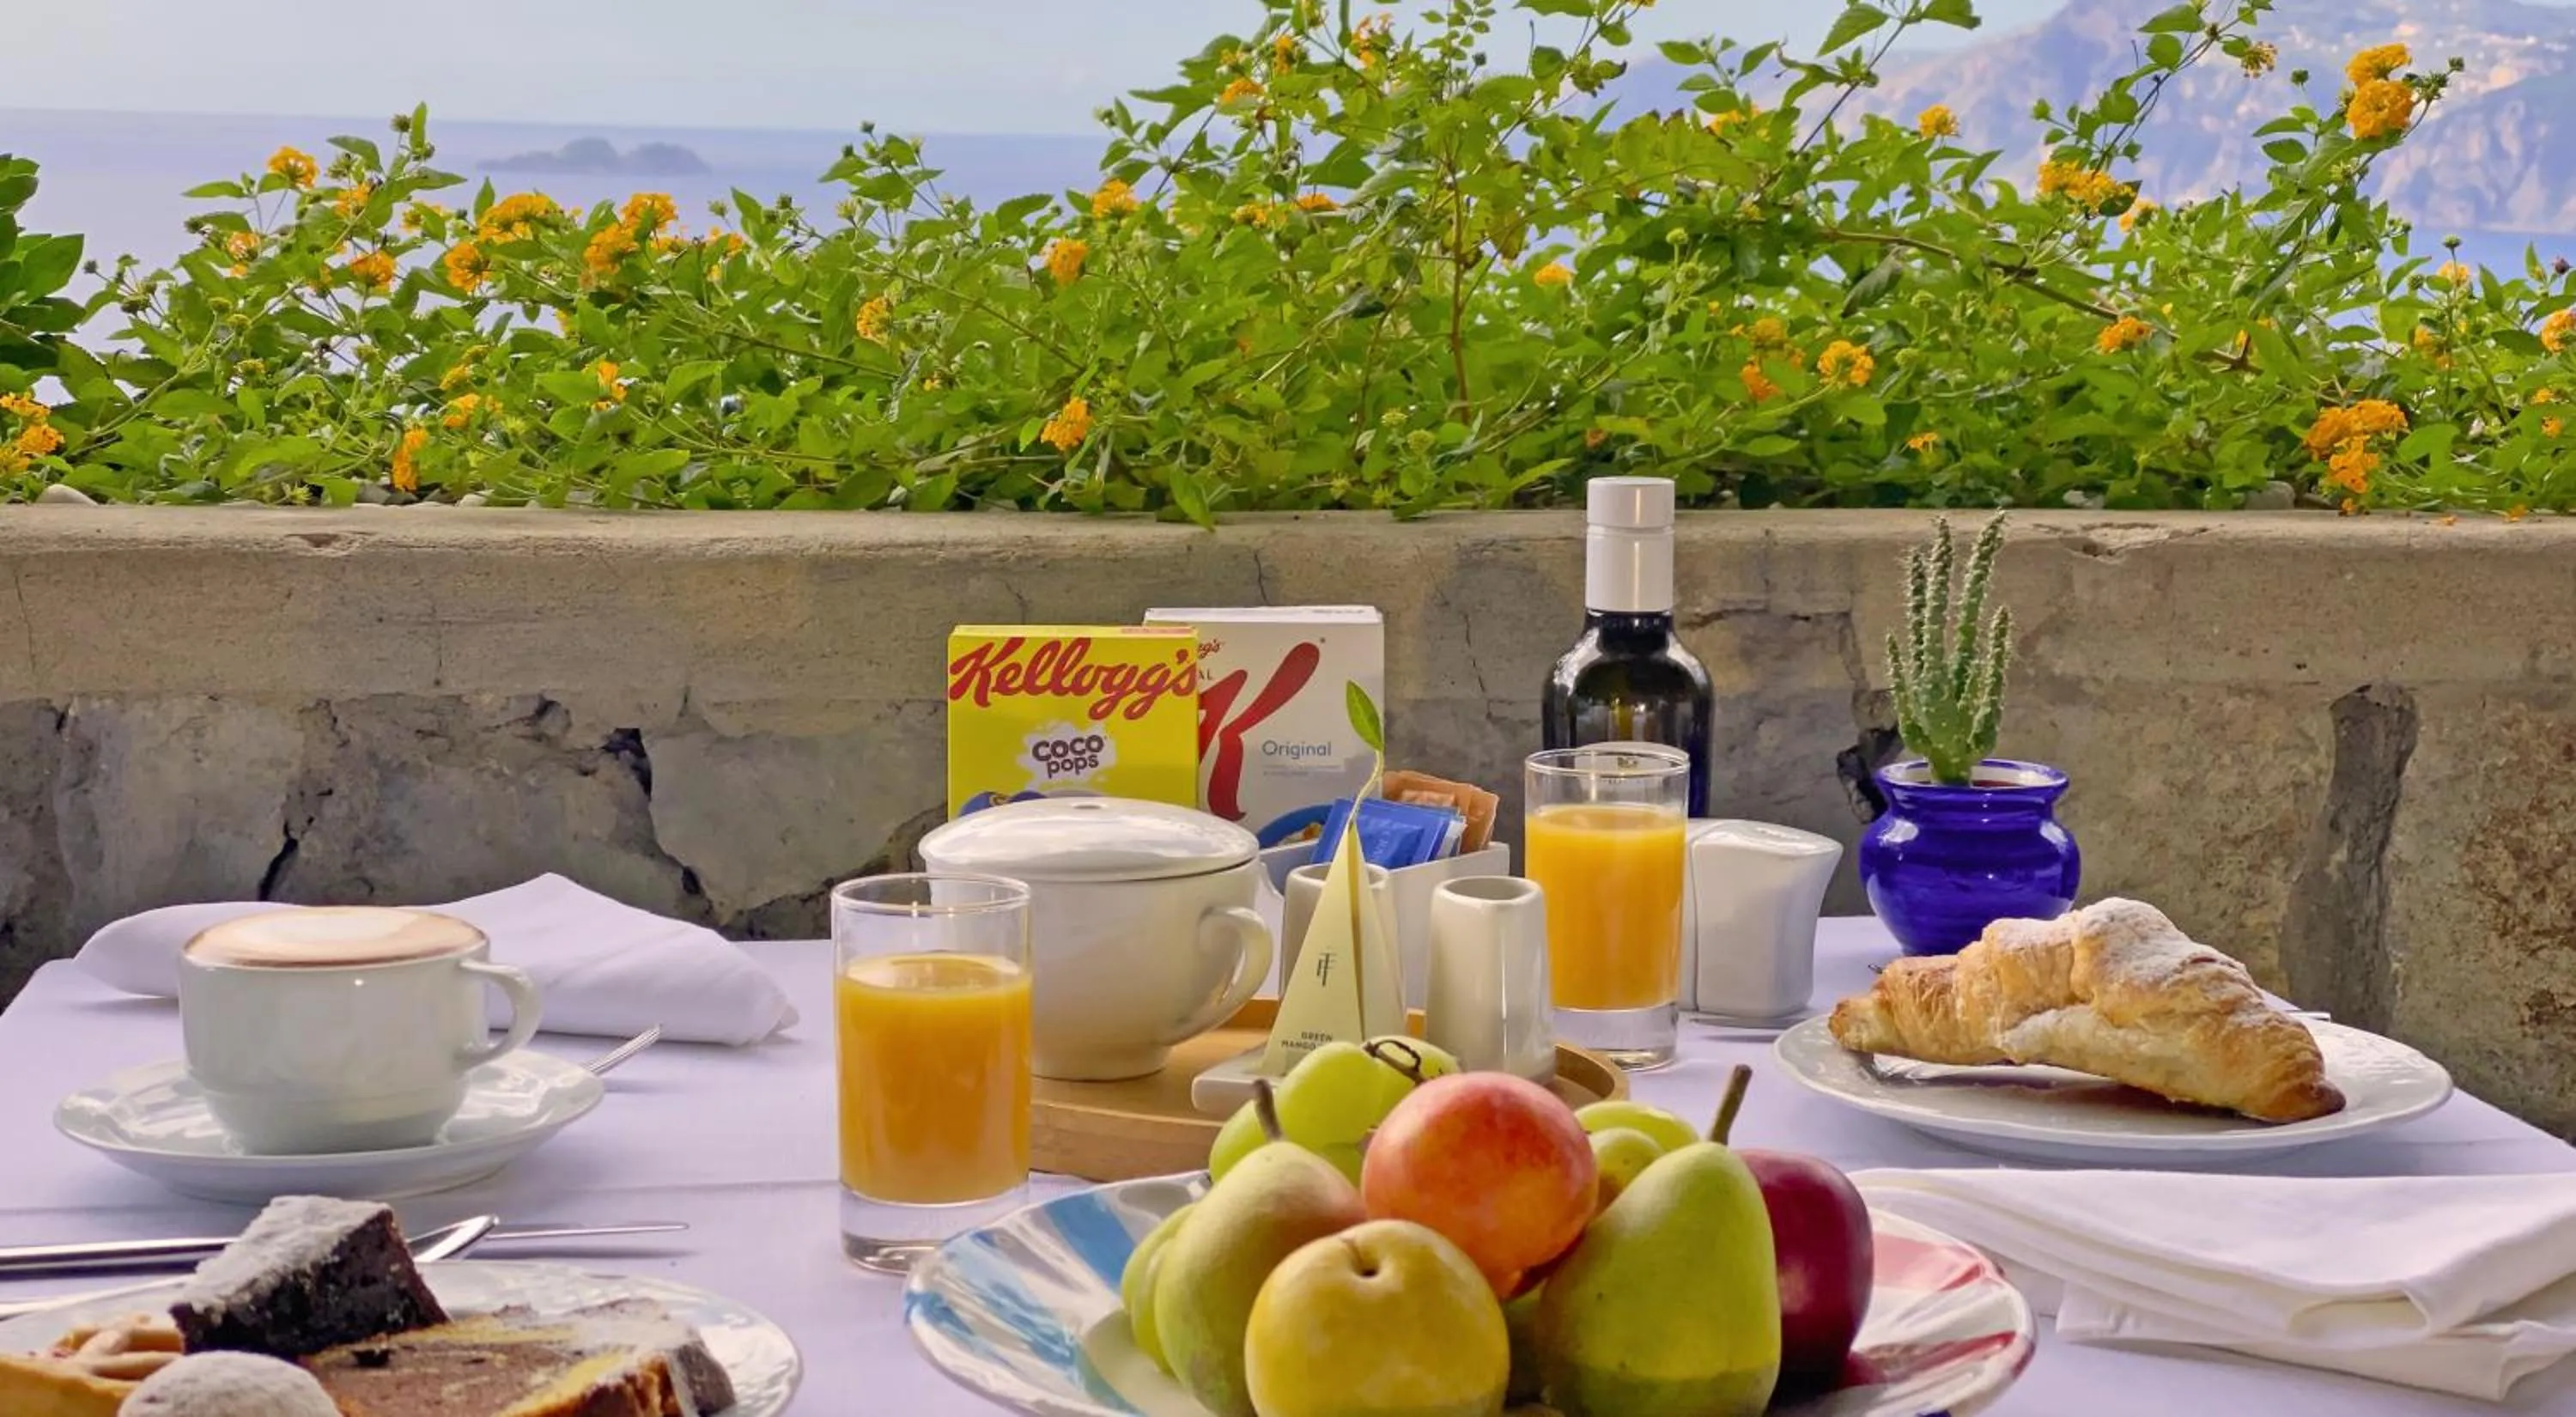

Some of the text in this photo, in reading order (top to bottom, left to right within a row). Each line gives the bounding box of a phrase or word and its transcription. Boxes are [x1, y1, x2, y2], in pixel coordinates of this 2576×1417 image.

[949, 636, 1197, 721] Kellogg's
[1198, 642, 1321, 822] K
[1262, 739, 1332, 760] Original
[1047, 754, 1099, 779] pops
[1281, 1039, 1317, 1052] MANGO
[1301, 1031, 1334, 1042] GREEN
